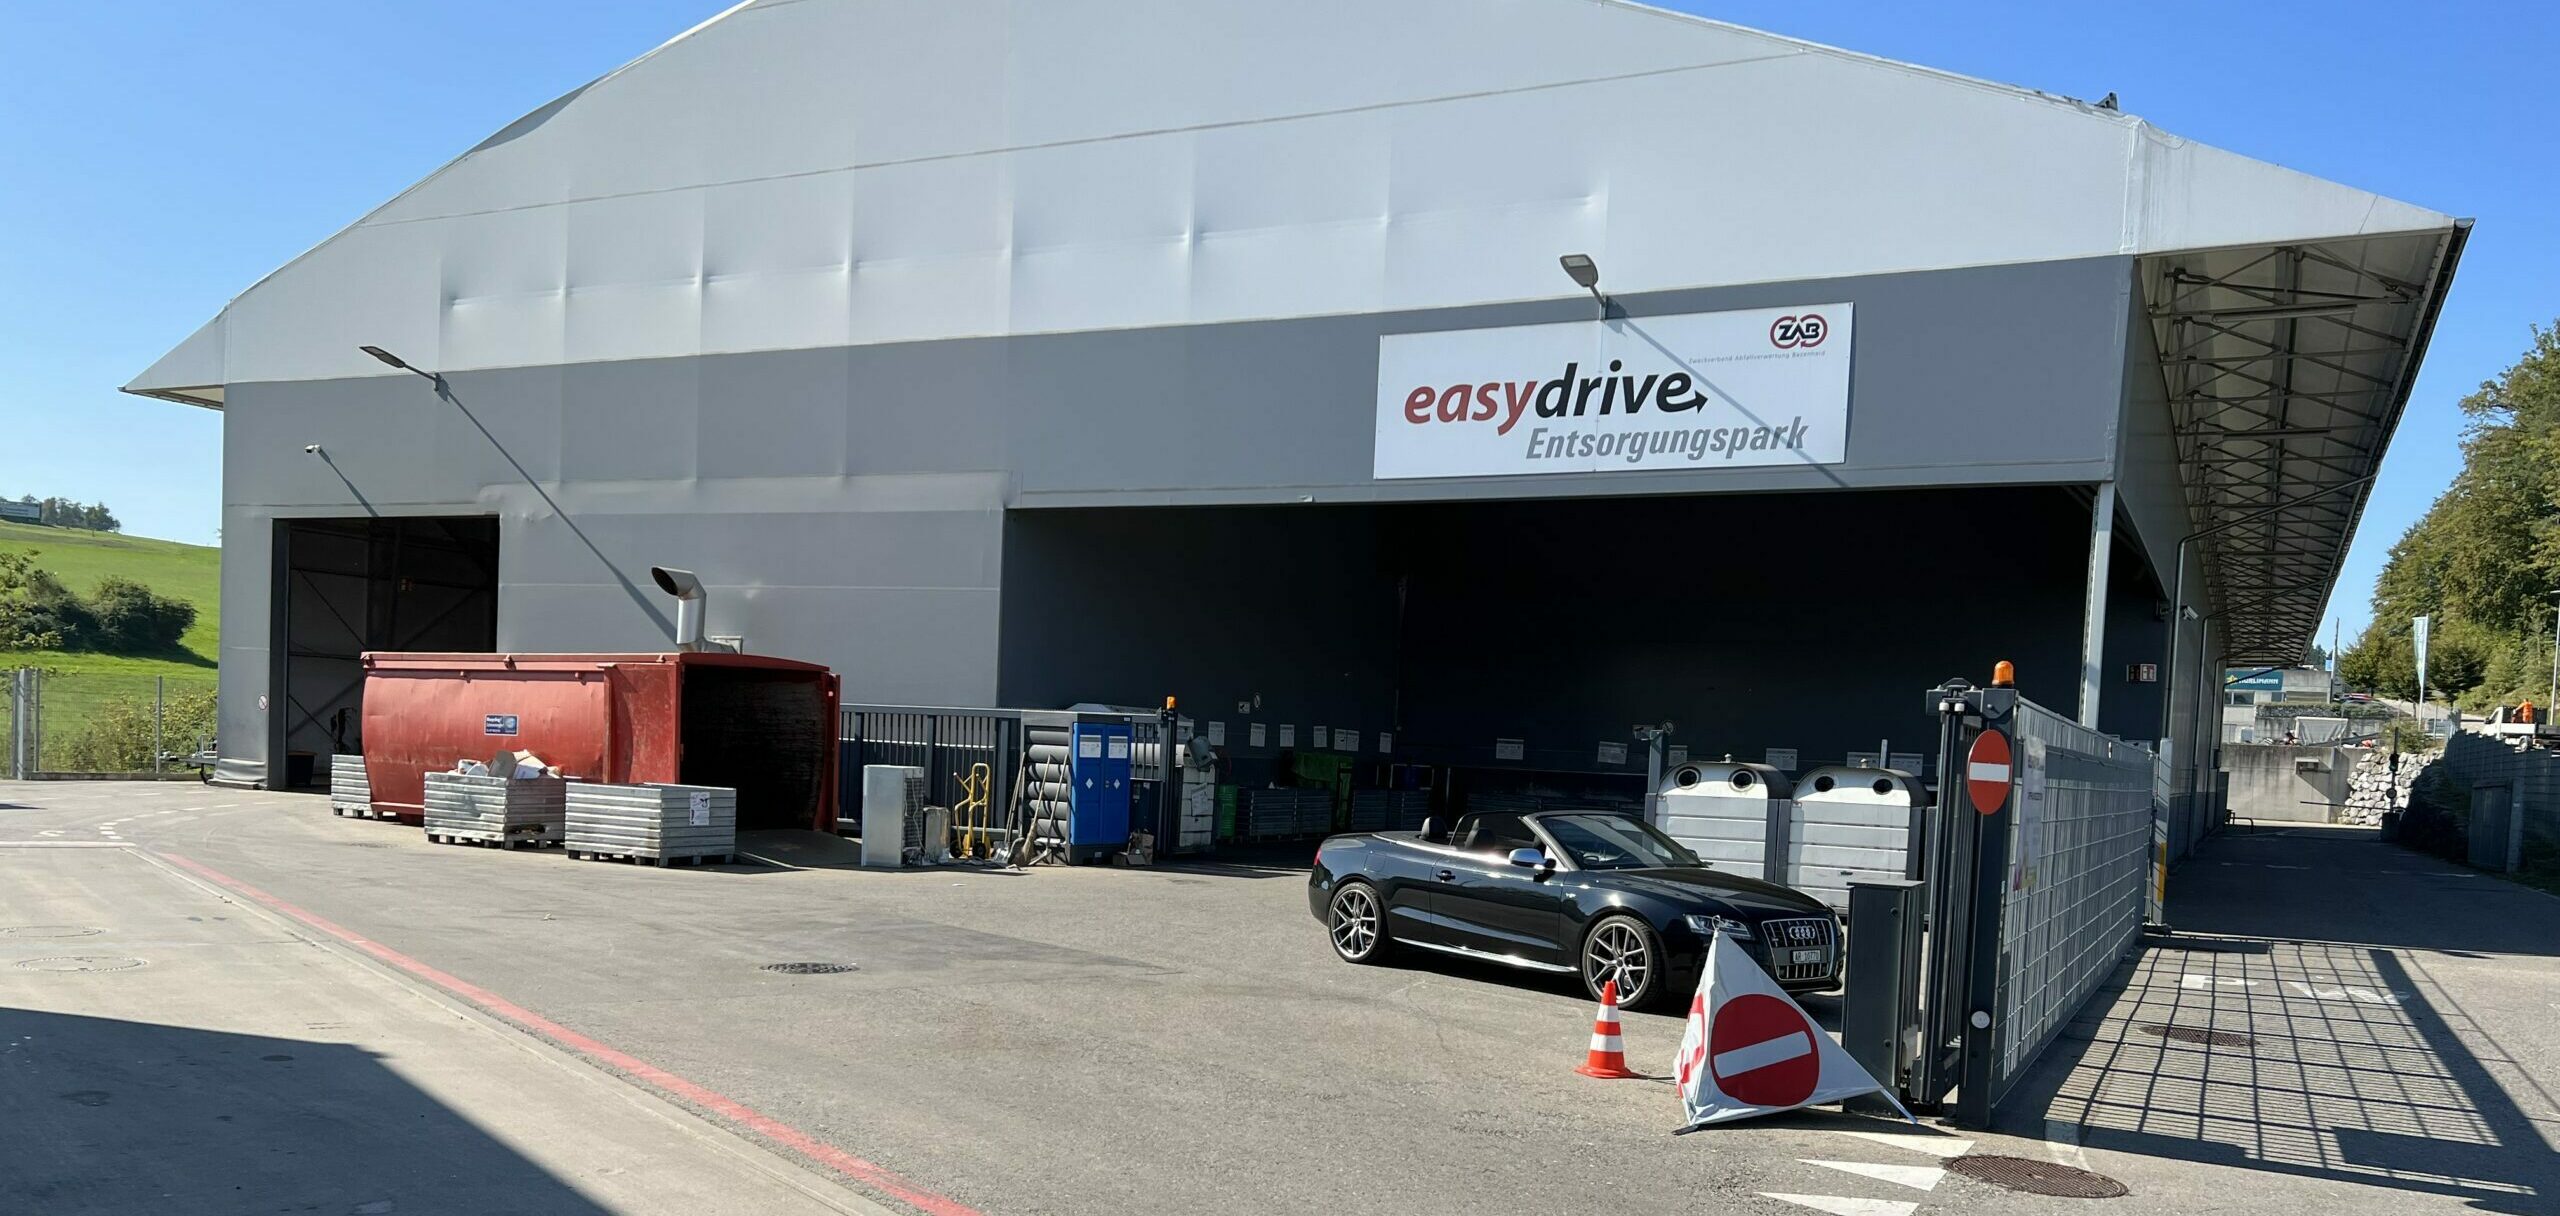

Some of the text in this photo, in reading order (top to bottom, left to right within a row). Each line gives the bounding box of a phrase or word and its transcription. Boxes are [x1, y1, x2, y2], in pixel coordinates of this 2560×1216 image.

[1778, 322, 1820, 341] ZAB
[1404, 360, 1695, 436] easydrive
[1526, 416, 1809, 463] Entsorgungspark
